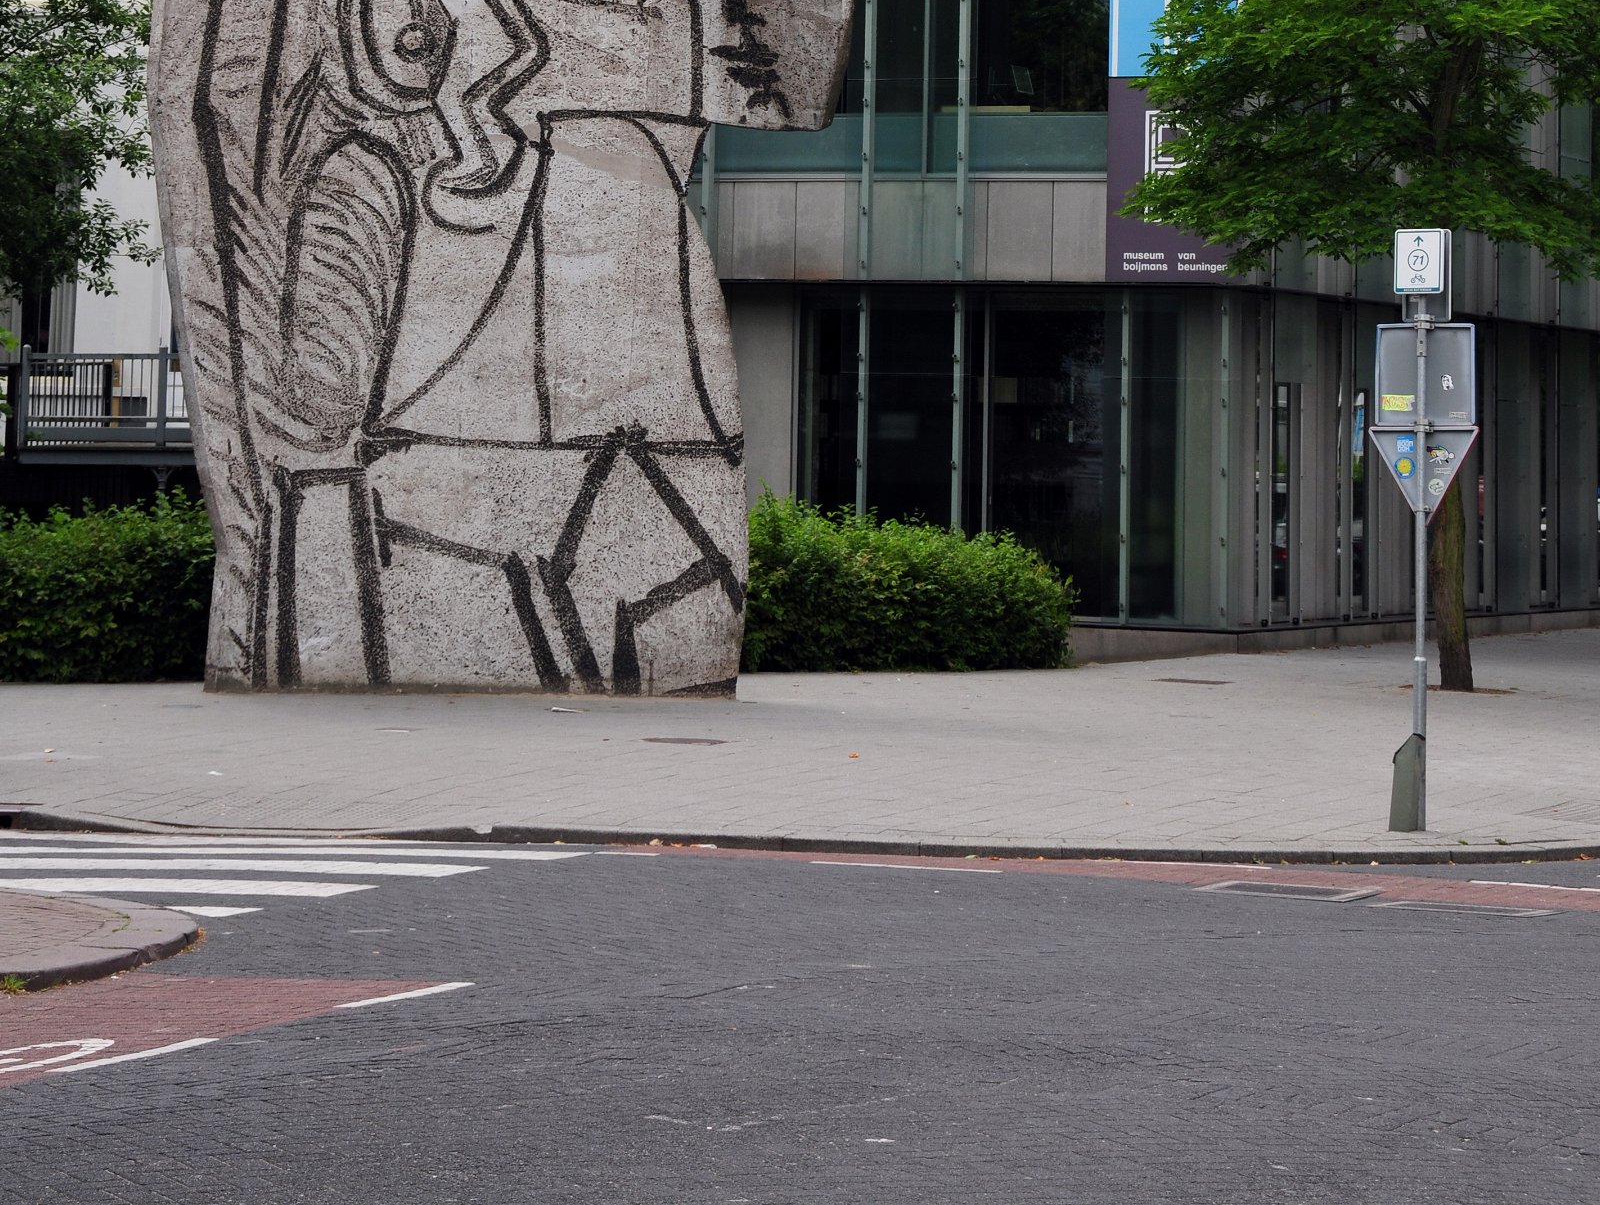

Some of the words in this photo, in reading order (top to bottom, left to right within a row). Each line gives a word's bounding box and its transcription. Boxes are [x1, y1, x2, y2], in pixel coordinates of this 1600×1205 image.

[1123, 252, 1165, 260] museum
[1178, 252, 1196, 260] van
[1412, 255, 1425, 266] 71
[1123, 261, 1168, 273] boijmans
